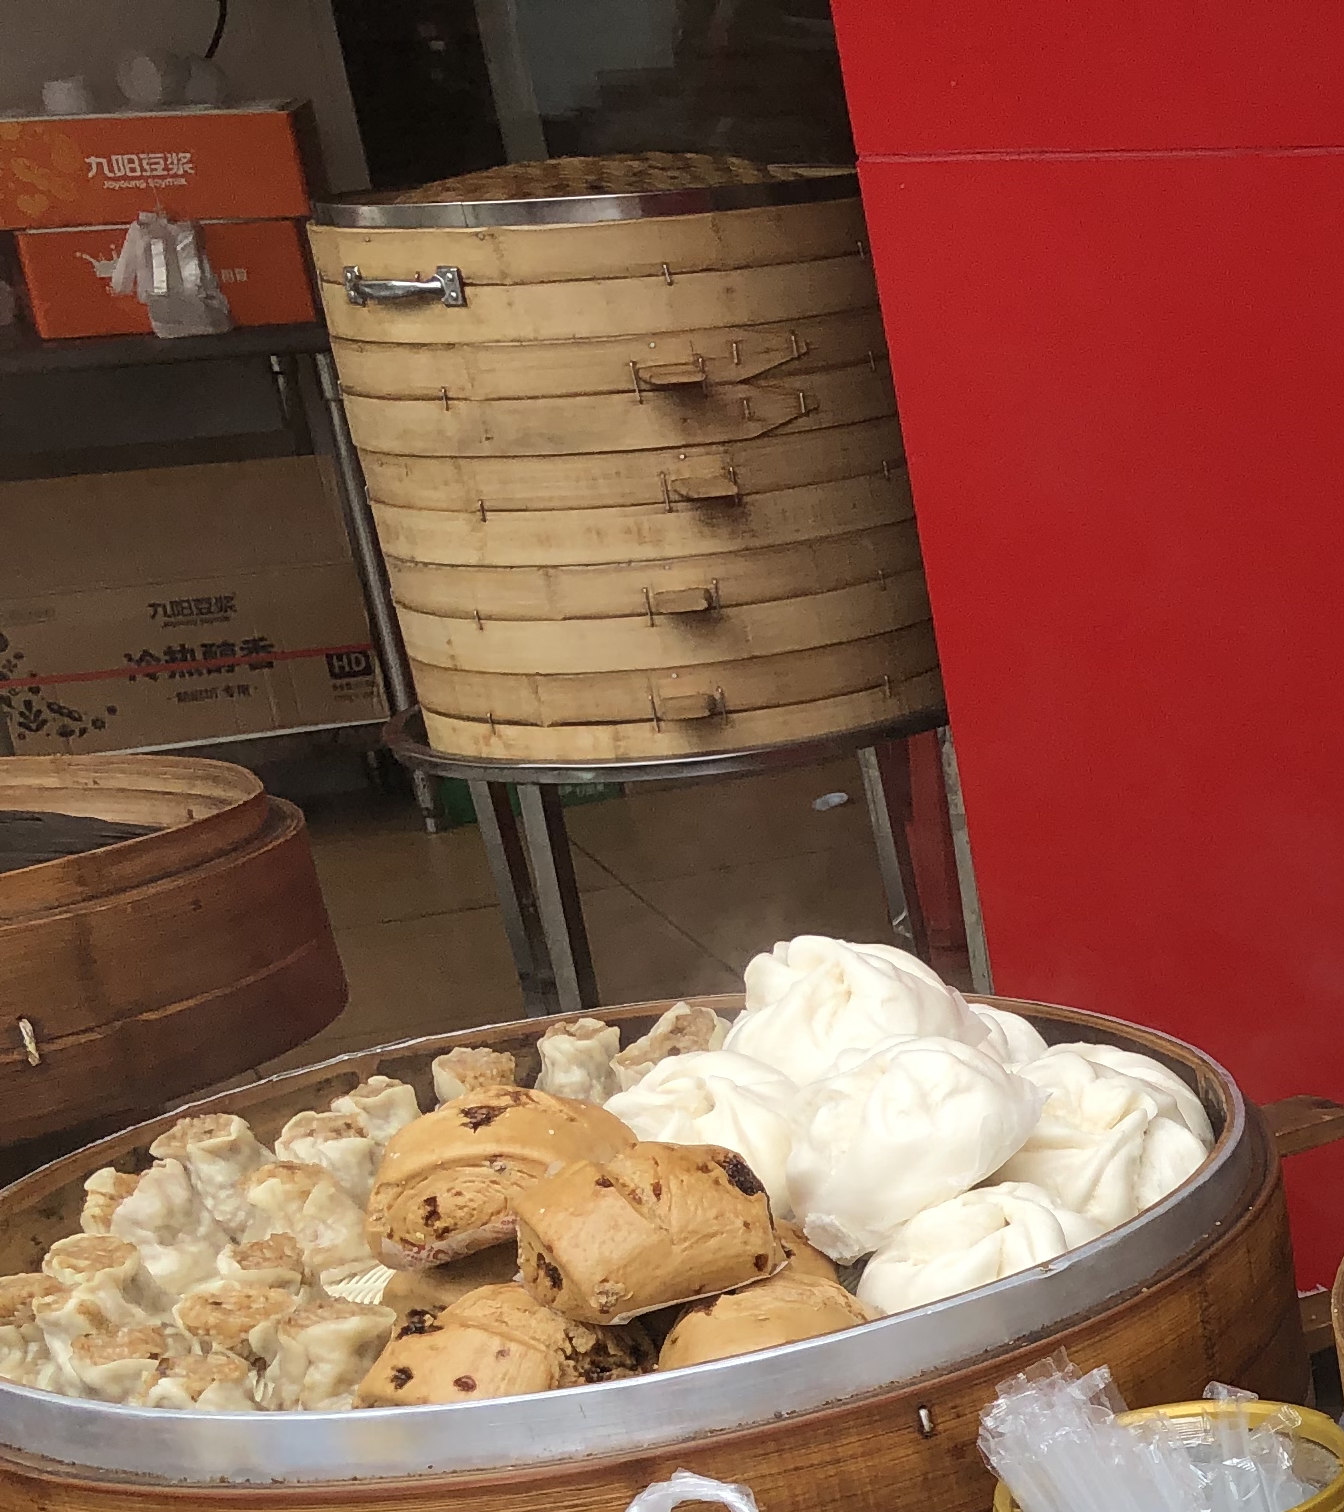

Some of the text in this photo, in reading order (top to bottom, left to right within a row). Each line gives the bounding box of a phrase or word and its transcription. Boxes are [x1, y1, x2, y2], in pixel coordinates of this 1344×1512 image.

[85, 152, 195, 178] 九阳豆浆
[148, 594, 237, 619] 九阳豆浆
[333, 653, 367, 673] HD
